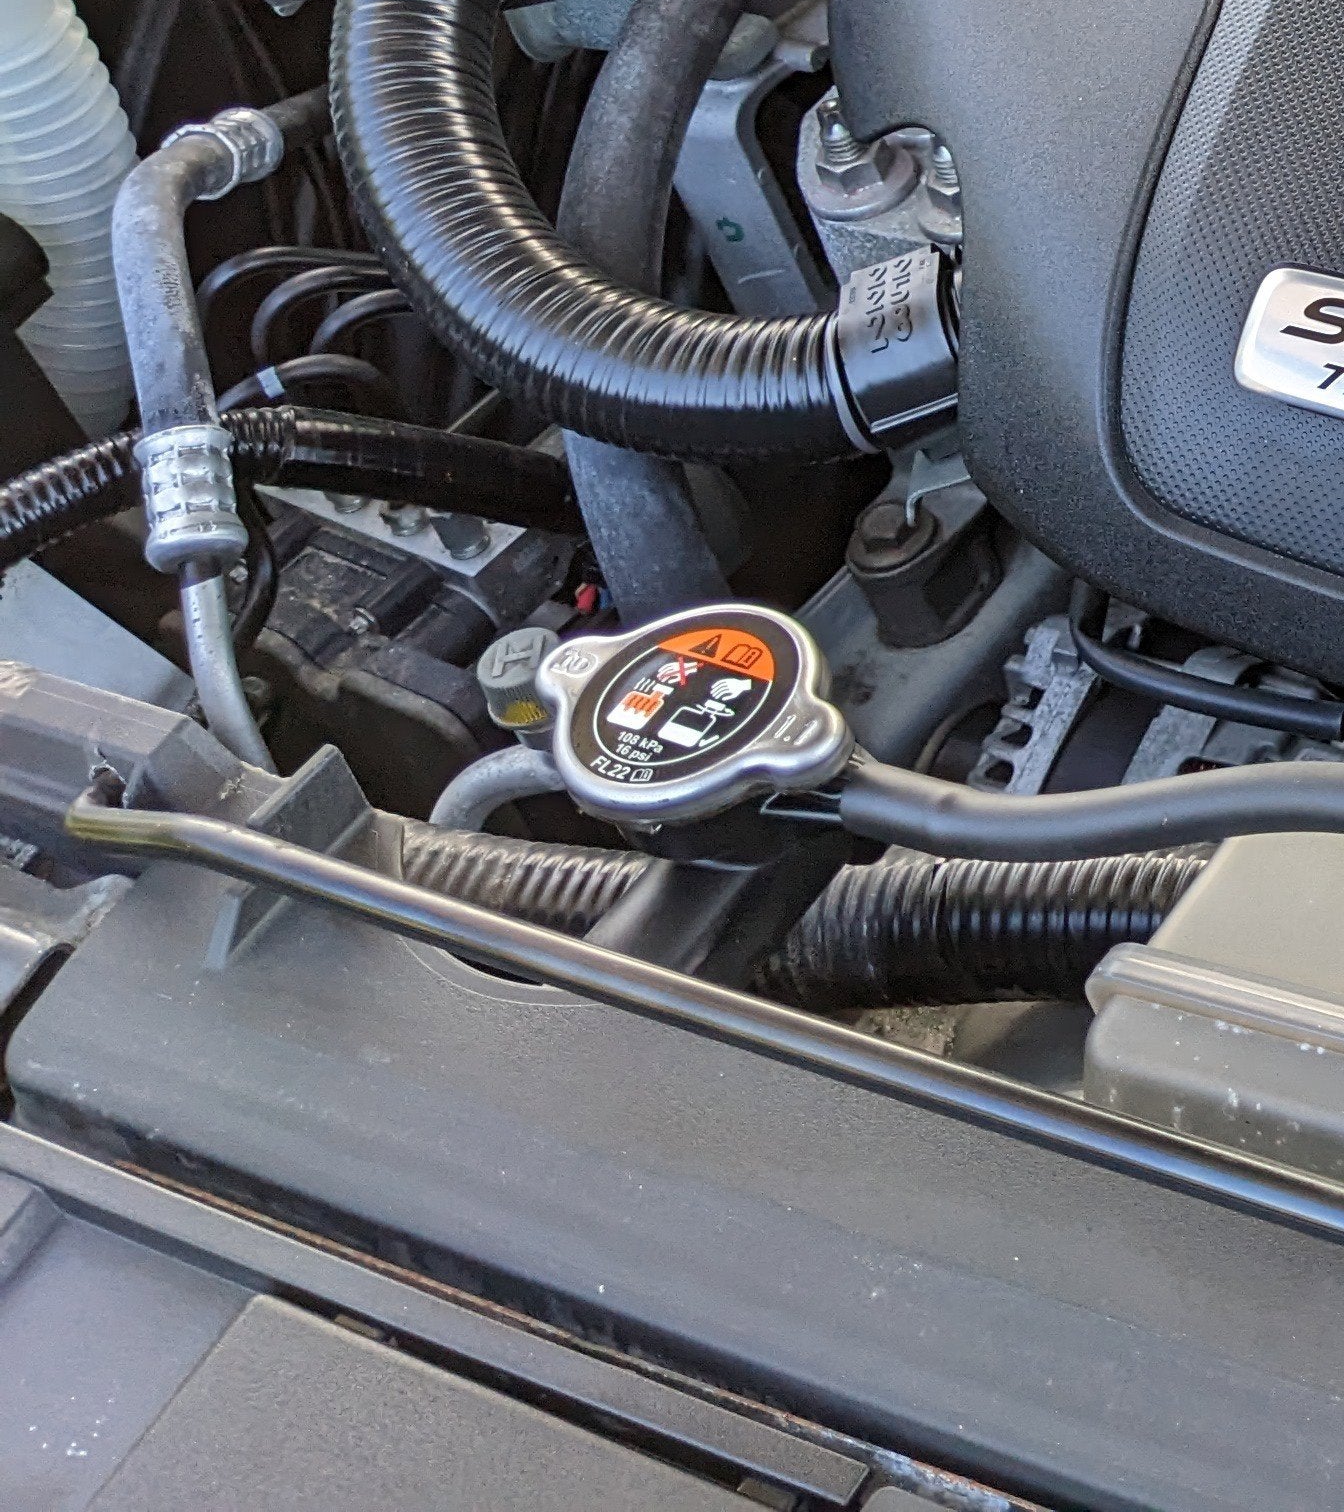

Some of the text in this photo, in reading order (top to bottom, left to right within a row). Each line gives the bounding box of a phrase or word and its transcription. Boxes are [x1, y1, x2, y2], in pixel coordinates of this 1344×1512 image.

[491, 634, 547, 678] H
[615, 743, 654, 762] 16 psi
[617, 731, 664, 754] 108 kPa
[589, 755, 632, 780] FL22
